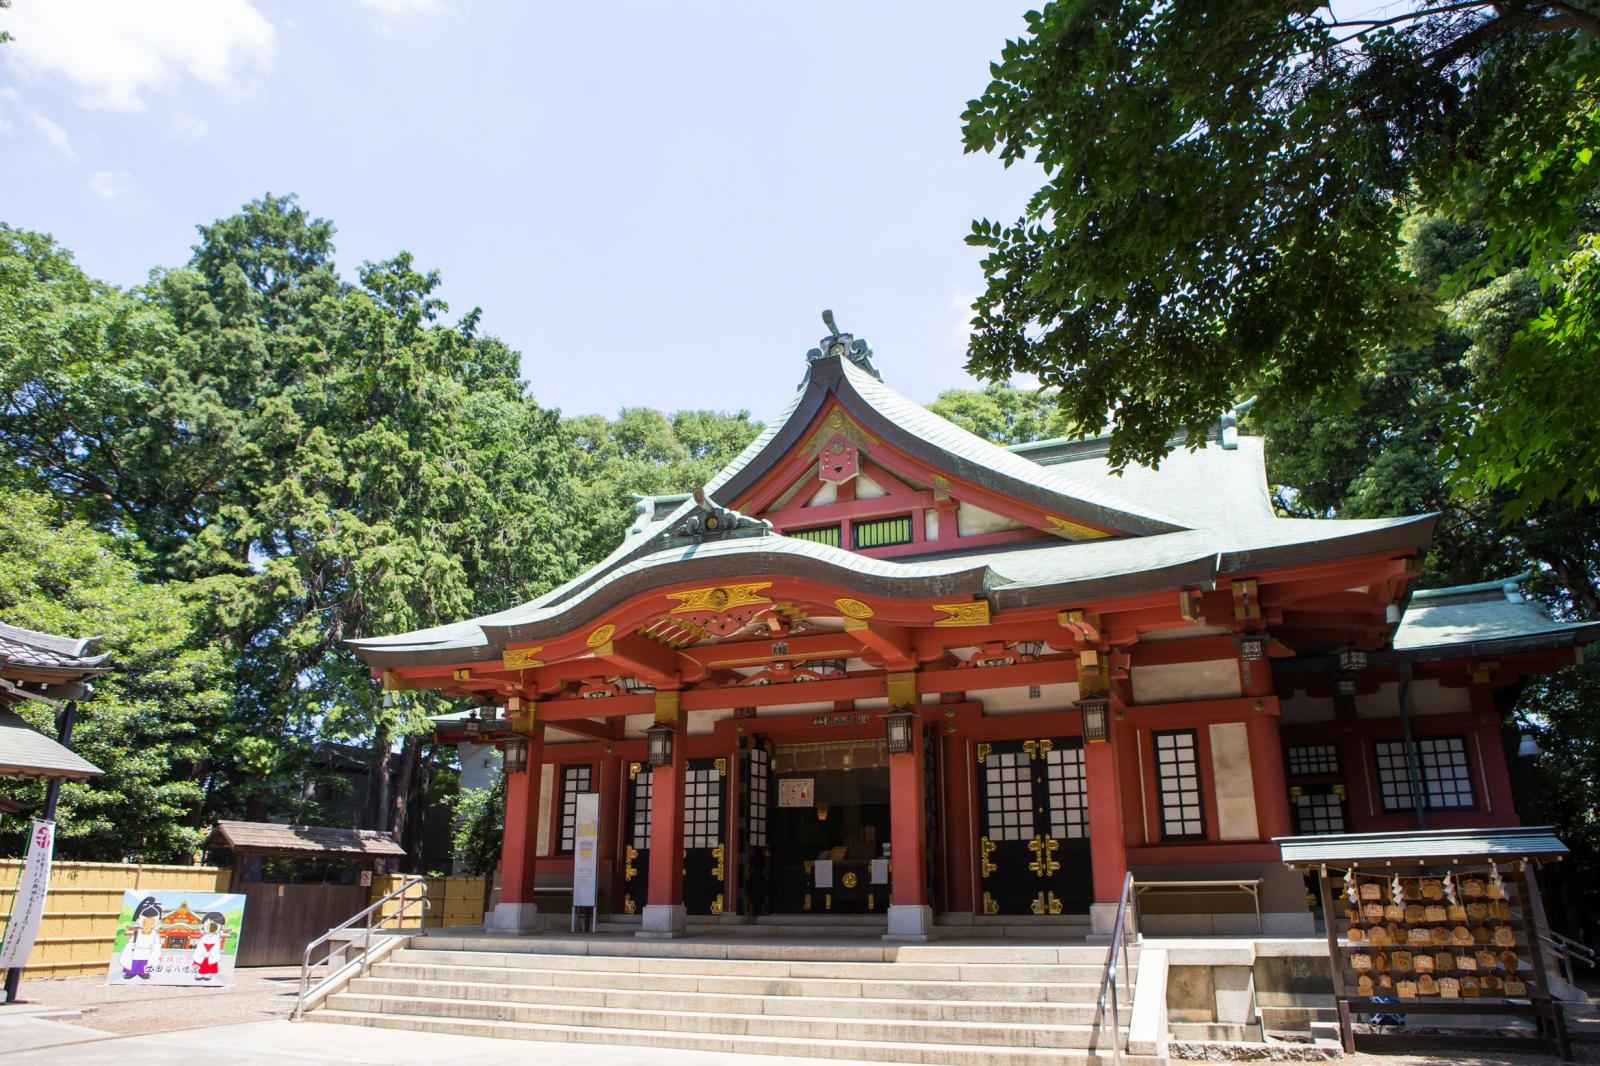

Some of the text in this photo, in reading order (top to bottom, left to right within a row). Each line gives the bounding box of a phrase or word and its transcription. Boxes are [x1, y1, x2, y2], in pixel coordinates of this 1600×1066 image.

[145, 965, 199, 974] 世田谷八幡宮
